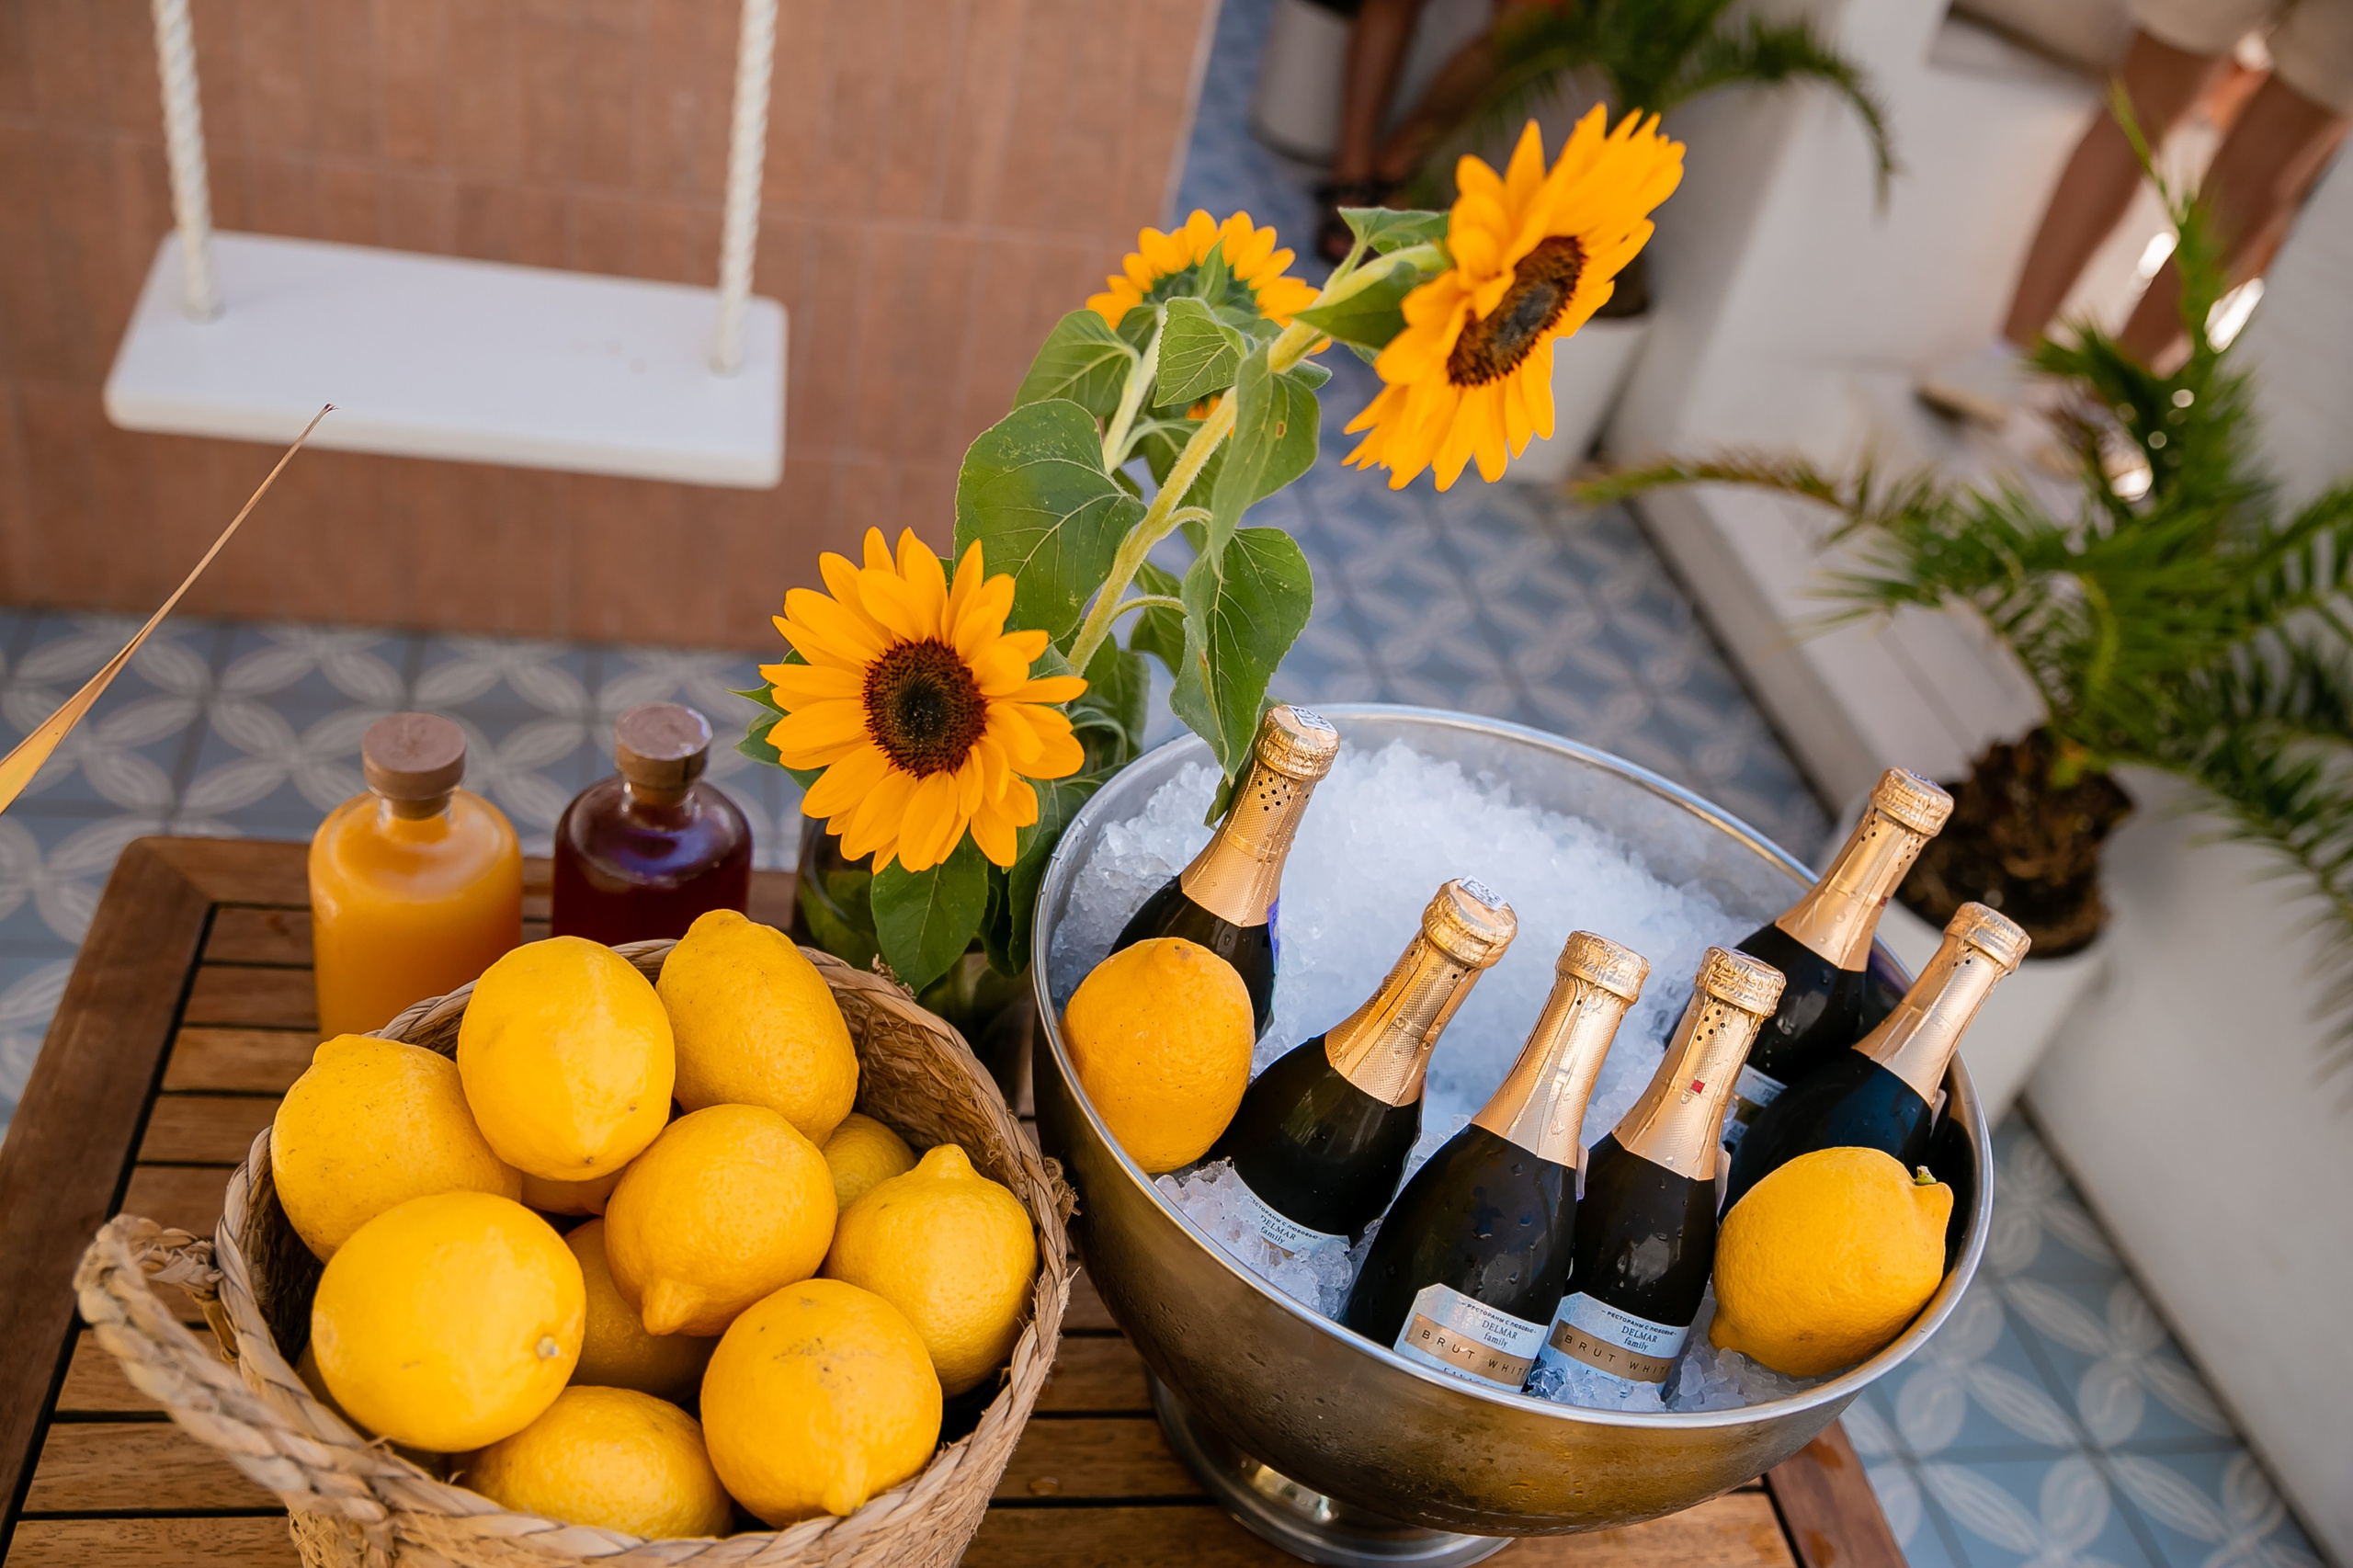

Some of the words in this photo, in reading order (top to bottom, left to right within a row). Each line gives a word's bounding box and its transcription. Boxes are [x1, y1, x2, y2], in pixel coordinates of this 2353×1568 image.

[1260, 1215, 1296, 1241] DELMAR
[1260, 1226, 1285, 1244] family
[1608, 1311, 1643, 1329] РЕСТОРАНЫ
[1482, 1320, 1518, 1340] DELMAR
[1621, 1326, 1658, 1343] DELMAR
[1422, 1330, 1475, 1359] BRUT
[1483, 1332, 1508, 1348] family
[1564, 1335, 1616, 1362] BRUT
[1624, 1337, 1648, 1351] family
